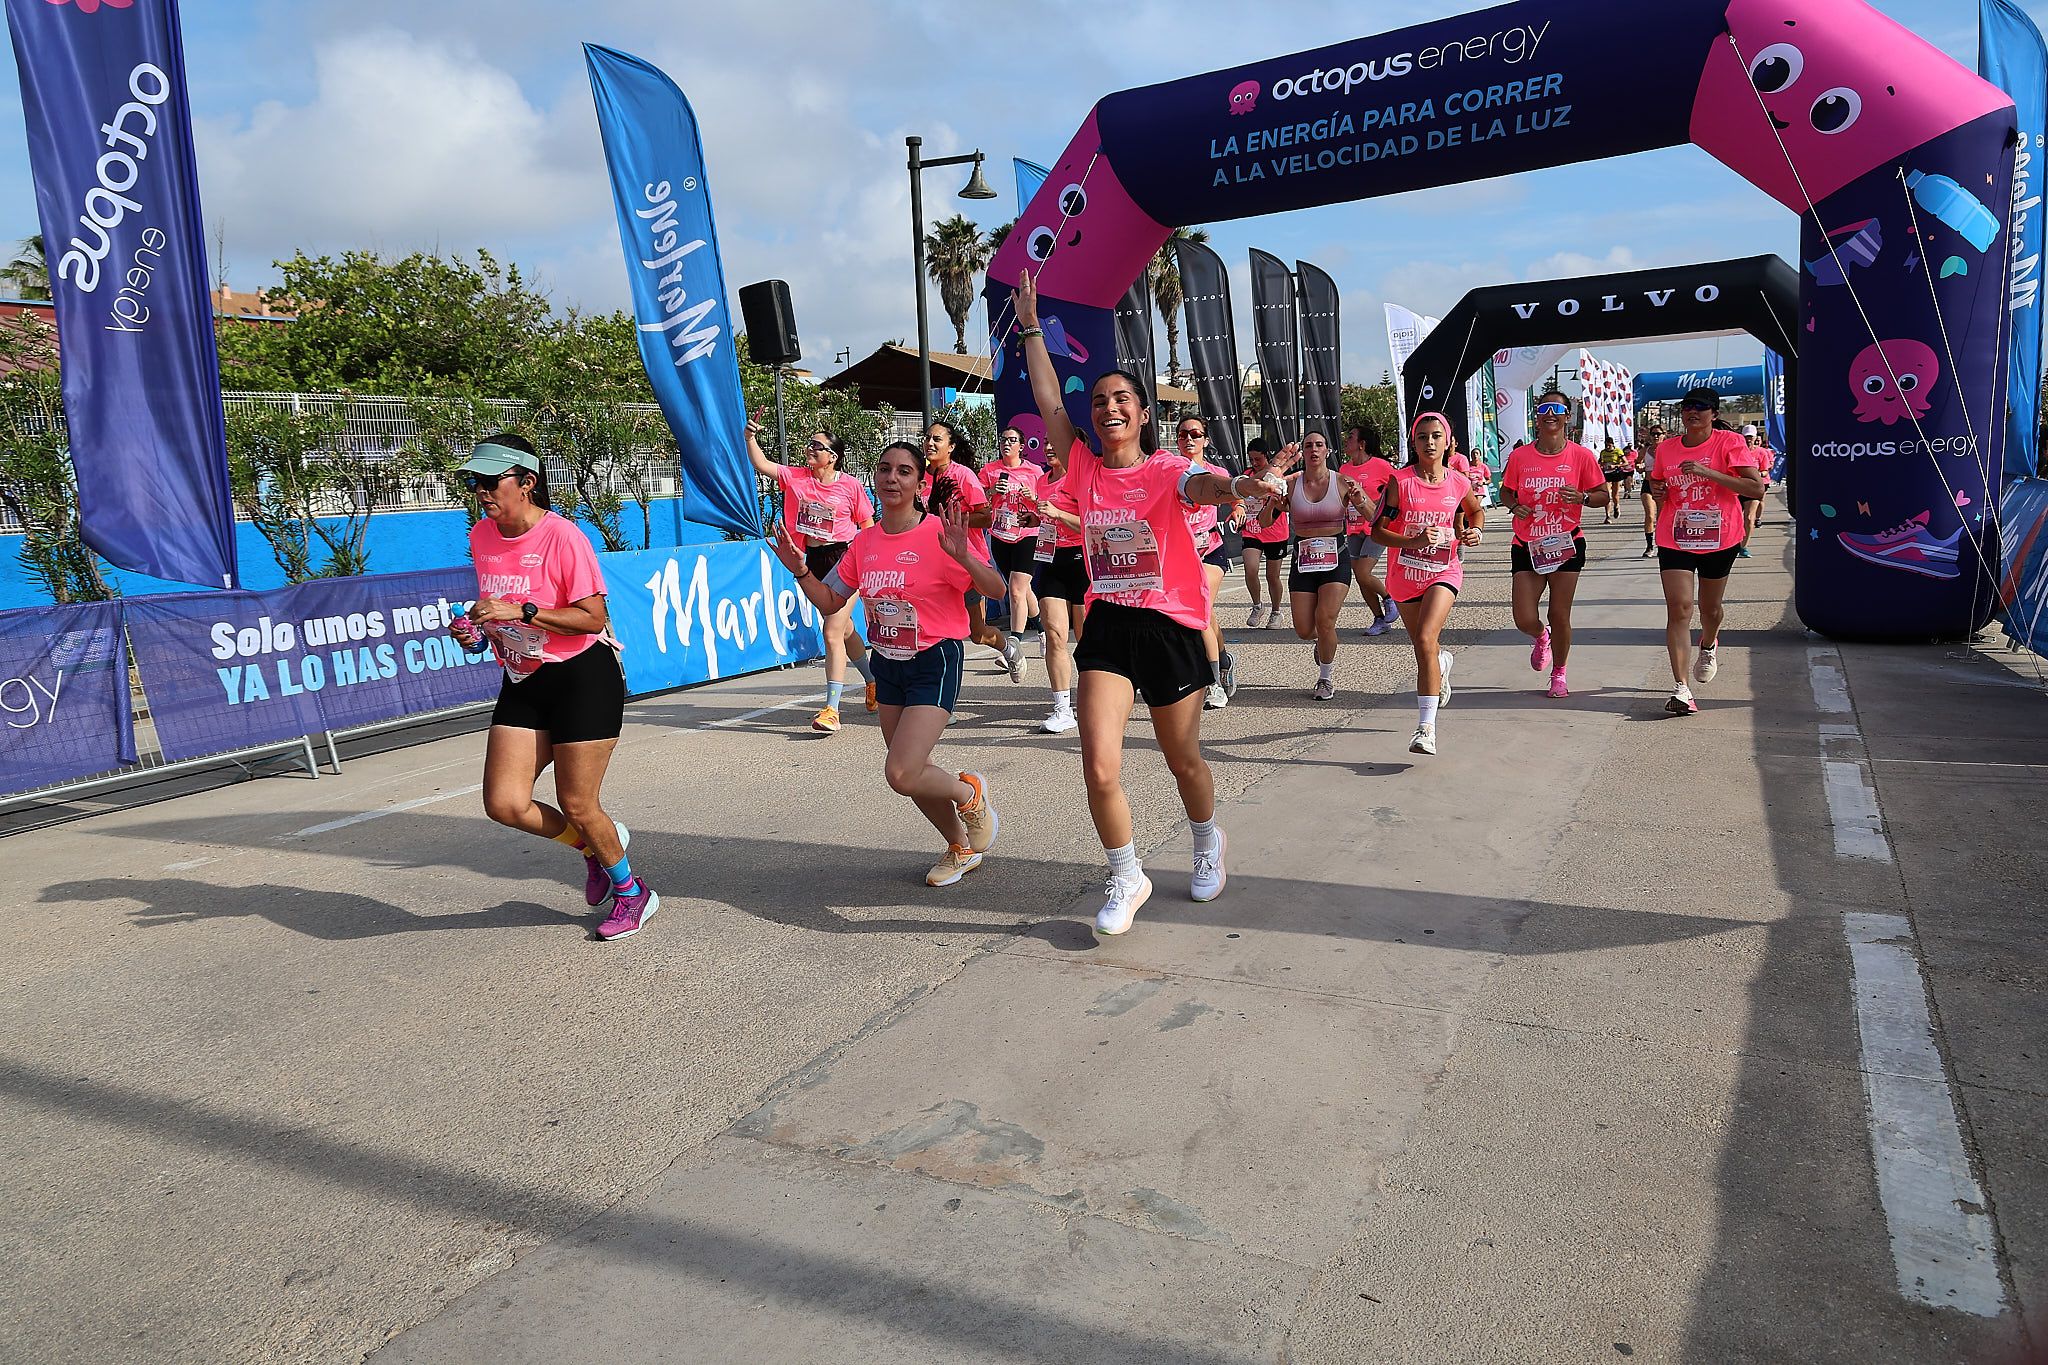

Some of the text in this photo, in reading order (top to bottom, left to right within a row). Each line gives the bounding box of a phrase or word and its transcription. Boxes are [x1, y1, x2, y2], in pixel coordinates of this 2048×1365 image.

[1272, 20, 1550, 101] octopus energy
[1210, 72, 1564, 159] LA ENERGÍA PARA CORRER
[1212, 104, 1573, 187] A LA VELOCIDAD DE LA LUZ
[1511, 284, 1719, 319] VOLVO
[1677, 371, 1733, 391] Marlene
[1812, 434, 1978, 461] octopus energy
[1525, 477, 1566, 488] CARRERA
[1546, 491, 1559, 504] DE
[1404, 511, 1451, 524] CARRERA
[1529, 523, 1563, 537] MUJER
[1111, 553, 1138, 566] 016
[1310, 552, 1326, 560] 016
[481, 573, 531, 595] CARRERA
[211, 616, 295, 660] Solo
[303, 611, 386, 647] unos
[880, 625, 898, 637] 016
[217, 664, 270, 705] YA
[277, 654, 326, 697] LO
[331, 643, 398, 687] HAS
